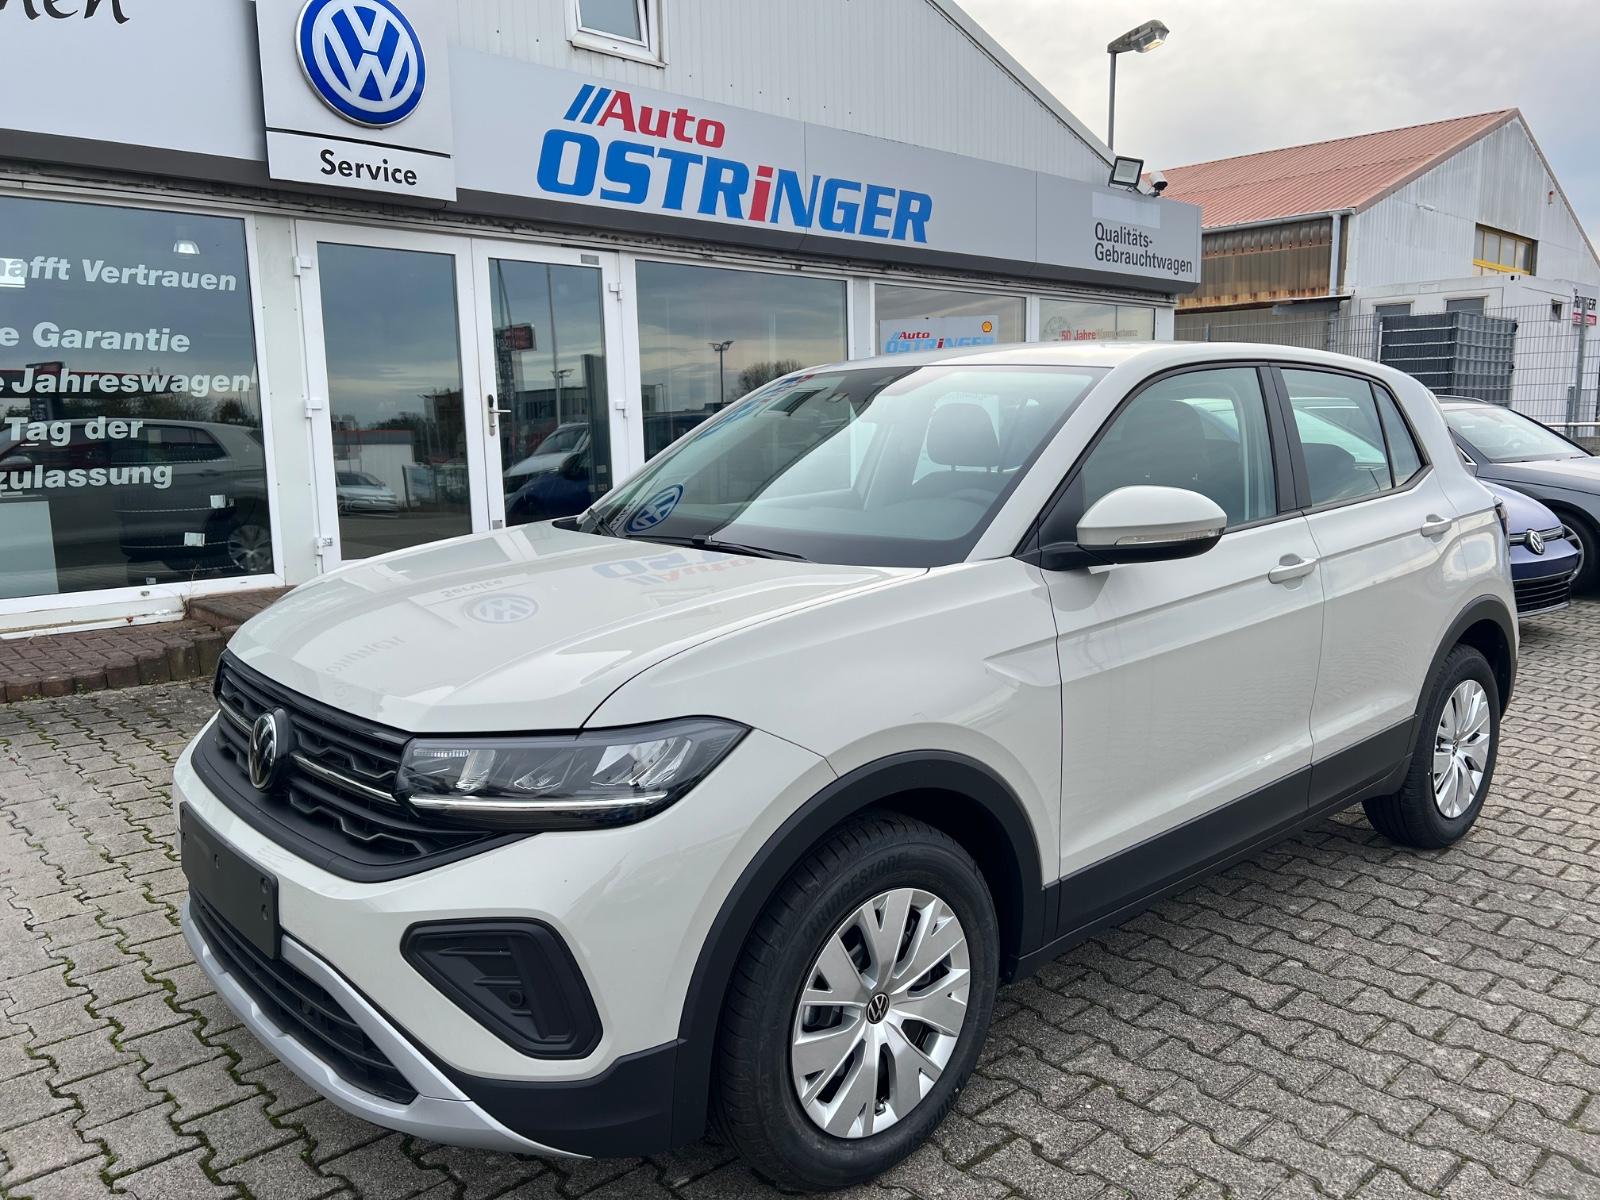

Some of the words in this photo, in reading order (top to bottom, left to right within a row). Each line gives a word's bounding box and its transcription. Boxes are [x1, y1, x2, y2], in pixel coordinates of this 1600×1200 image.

[597, 90, 725, 149] Auto
[319, 148, 418, 186] Service
[1094, 221, 1153, 248] Qualitäts-
[1094, 243, 1193, 275] Gebrauchtwagen
[82, 259, 237, 291] Vertrauen
[32, 321, 190, 352] Garantie
[898, 331, 930, 340] Auto
[11, 368, 249, 397] Jahreswagen
[5, 416, 71, 447] Tag
[84, 416, 144, 440] der
